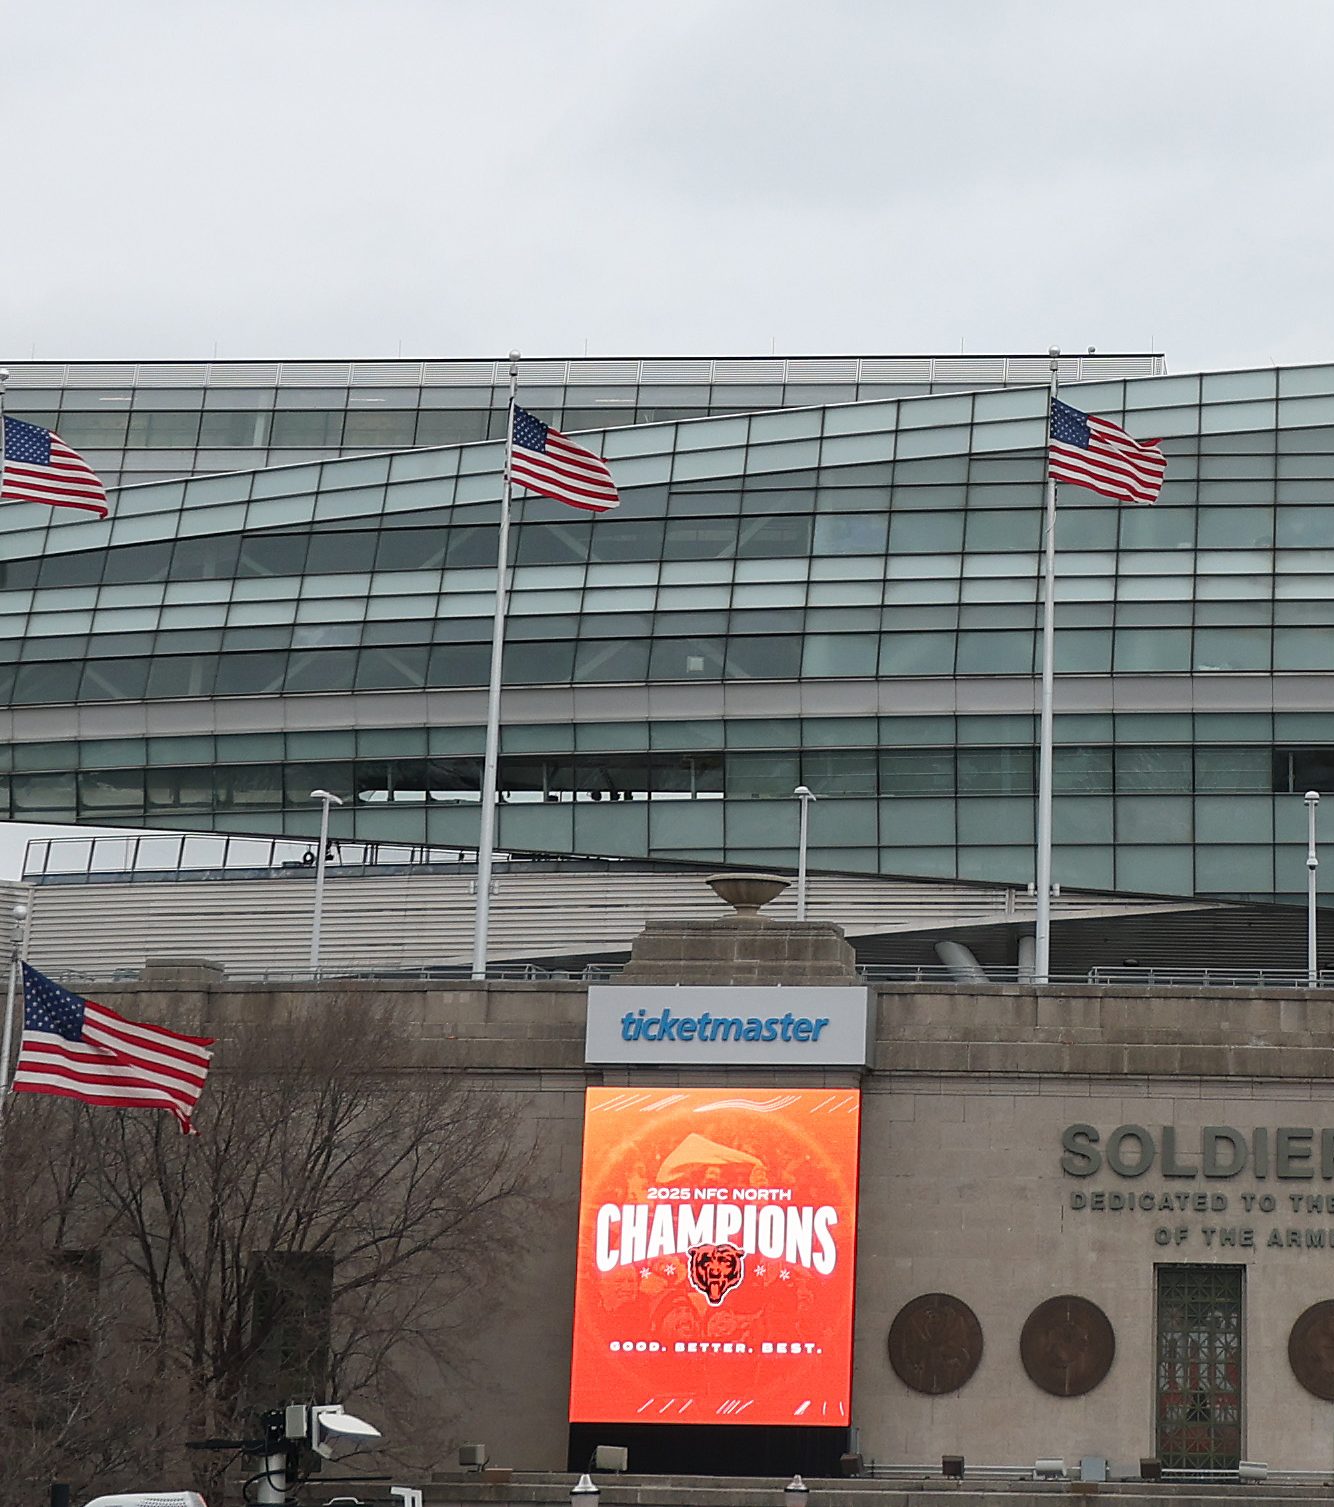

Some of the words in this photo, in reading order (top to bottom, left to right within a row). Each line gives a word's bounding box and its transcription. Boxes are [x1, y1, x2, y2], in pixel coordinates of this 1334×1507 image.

[620, 1008, 828, 1042] ticketmaster
[647, 1188, 691, 1201] 2025
[694, 1188, 729, 1201] NFC
[732, 1189, 792, 1202] NORTH
[1070, 1191, 1228, 1212] DEDICATED
[1240, 1193, 1276, 1213] TO
[596, 1202, 838, 1275] CHAMPIONS
[1154, 1227, 1190, 1246] OF
[1202, 1228, 1255, 1248] THE
[609, 1341, 667, 1353] GOOD.
[675, 1342, 753, 1354] BETTER.
[761, 1342, 823, 1355] BEST.
